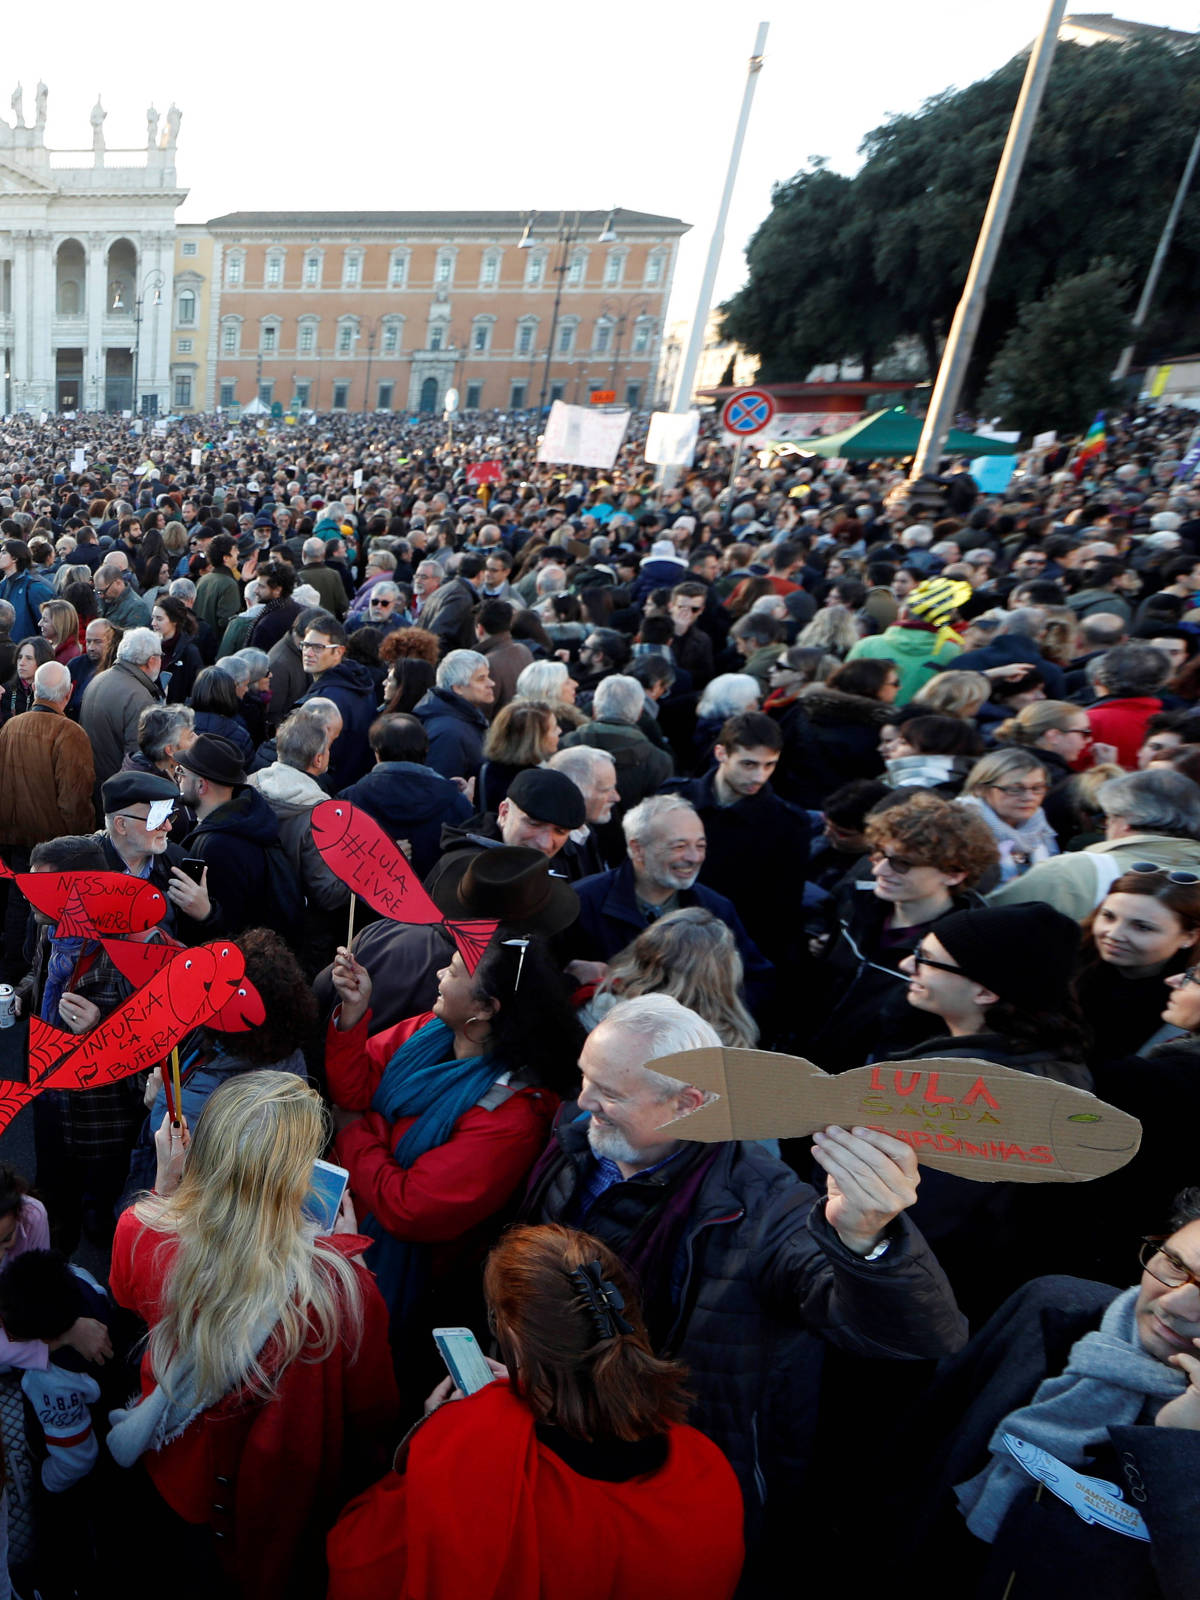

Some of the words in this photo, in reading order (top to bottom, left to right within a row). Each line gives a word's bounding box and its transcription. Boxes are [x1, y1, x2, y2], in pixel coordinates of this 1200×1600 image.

[56, 876, 138, 897] NESSUNO
[119, 1033, 141, 1050] LA
[870, 1066, 1001, 1110] LULA
